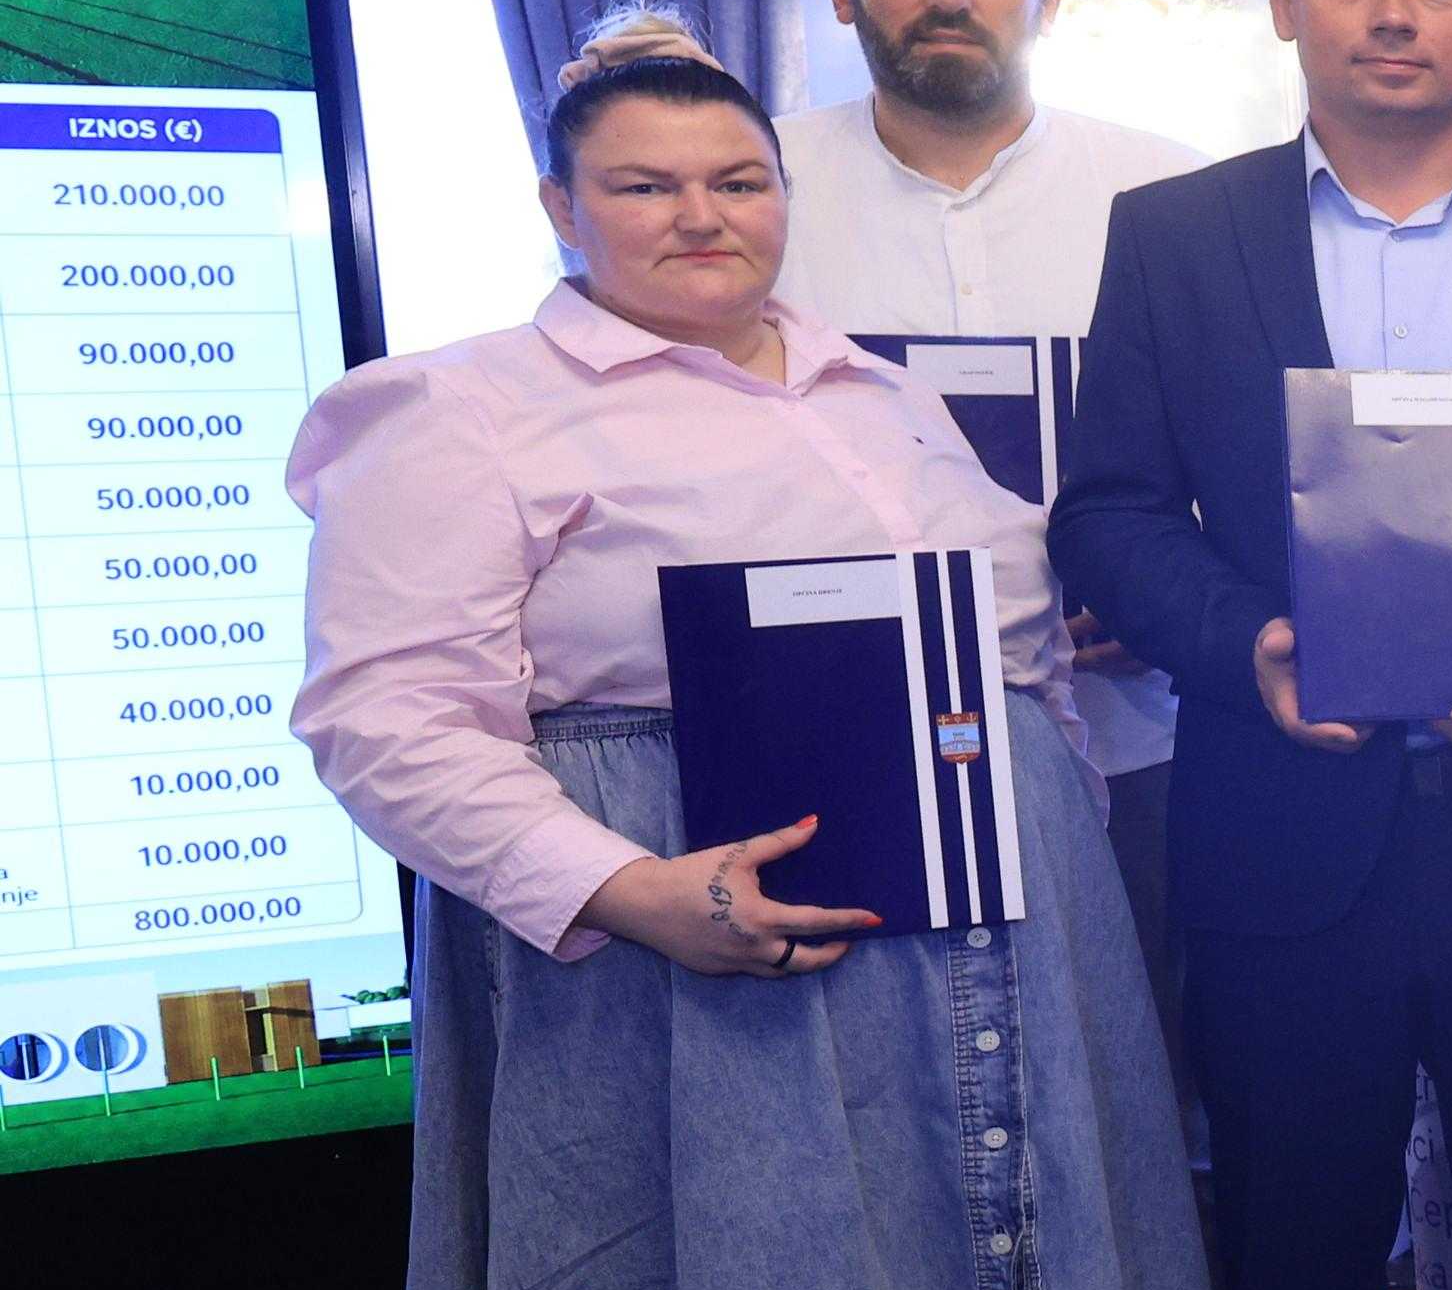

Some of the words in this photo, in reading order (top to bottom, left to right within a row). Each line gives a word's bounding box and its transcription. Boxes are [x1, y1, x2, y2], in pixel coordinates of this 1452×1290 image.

[69, 117, 157, 140] IZNOS
[165, 119, 203, 142] (€)
[52, 182, 226, 209] 210.000,00
[61, 264, 235, 290] 200.000,00
[78, 341, 235, 368] 90.000,00
[87, 414, 243, 441] 90.000,00
[96, 484, 250, 511] 50.000,00
[104, 553, 258, 580] 50.000,00
[111, 621, 265, 650] 50.000,00
[119, 693, 273, 724] 40.000,00
[129, 764, 280, 796] 10.000,00
[138, 834, 288, 868] 10.000,00
[134, 895, 302, 931] 800.000,00
